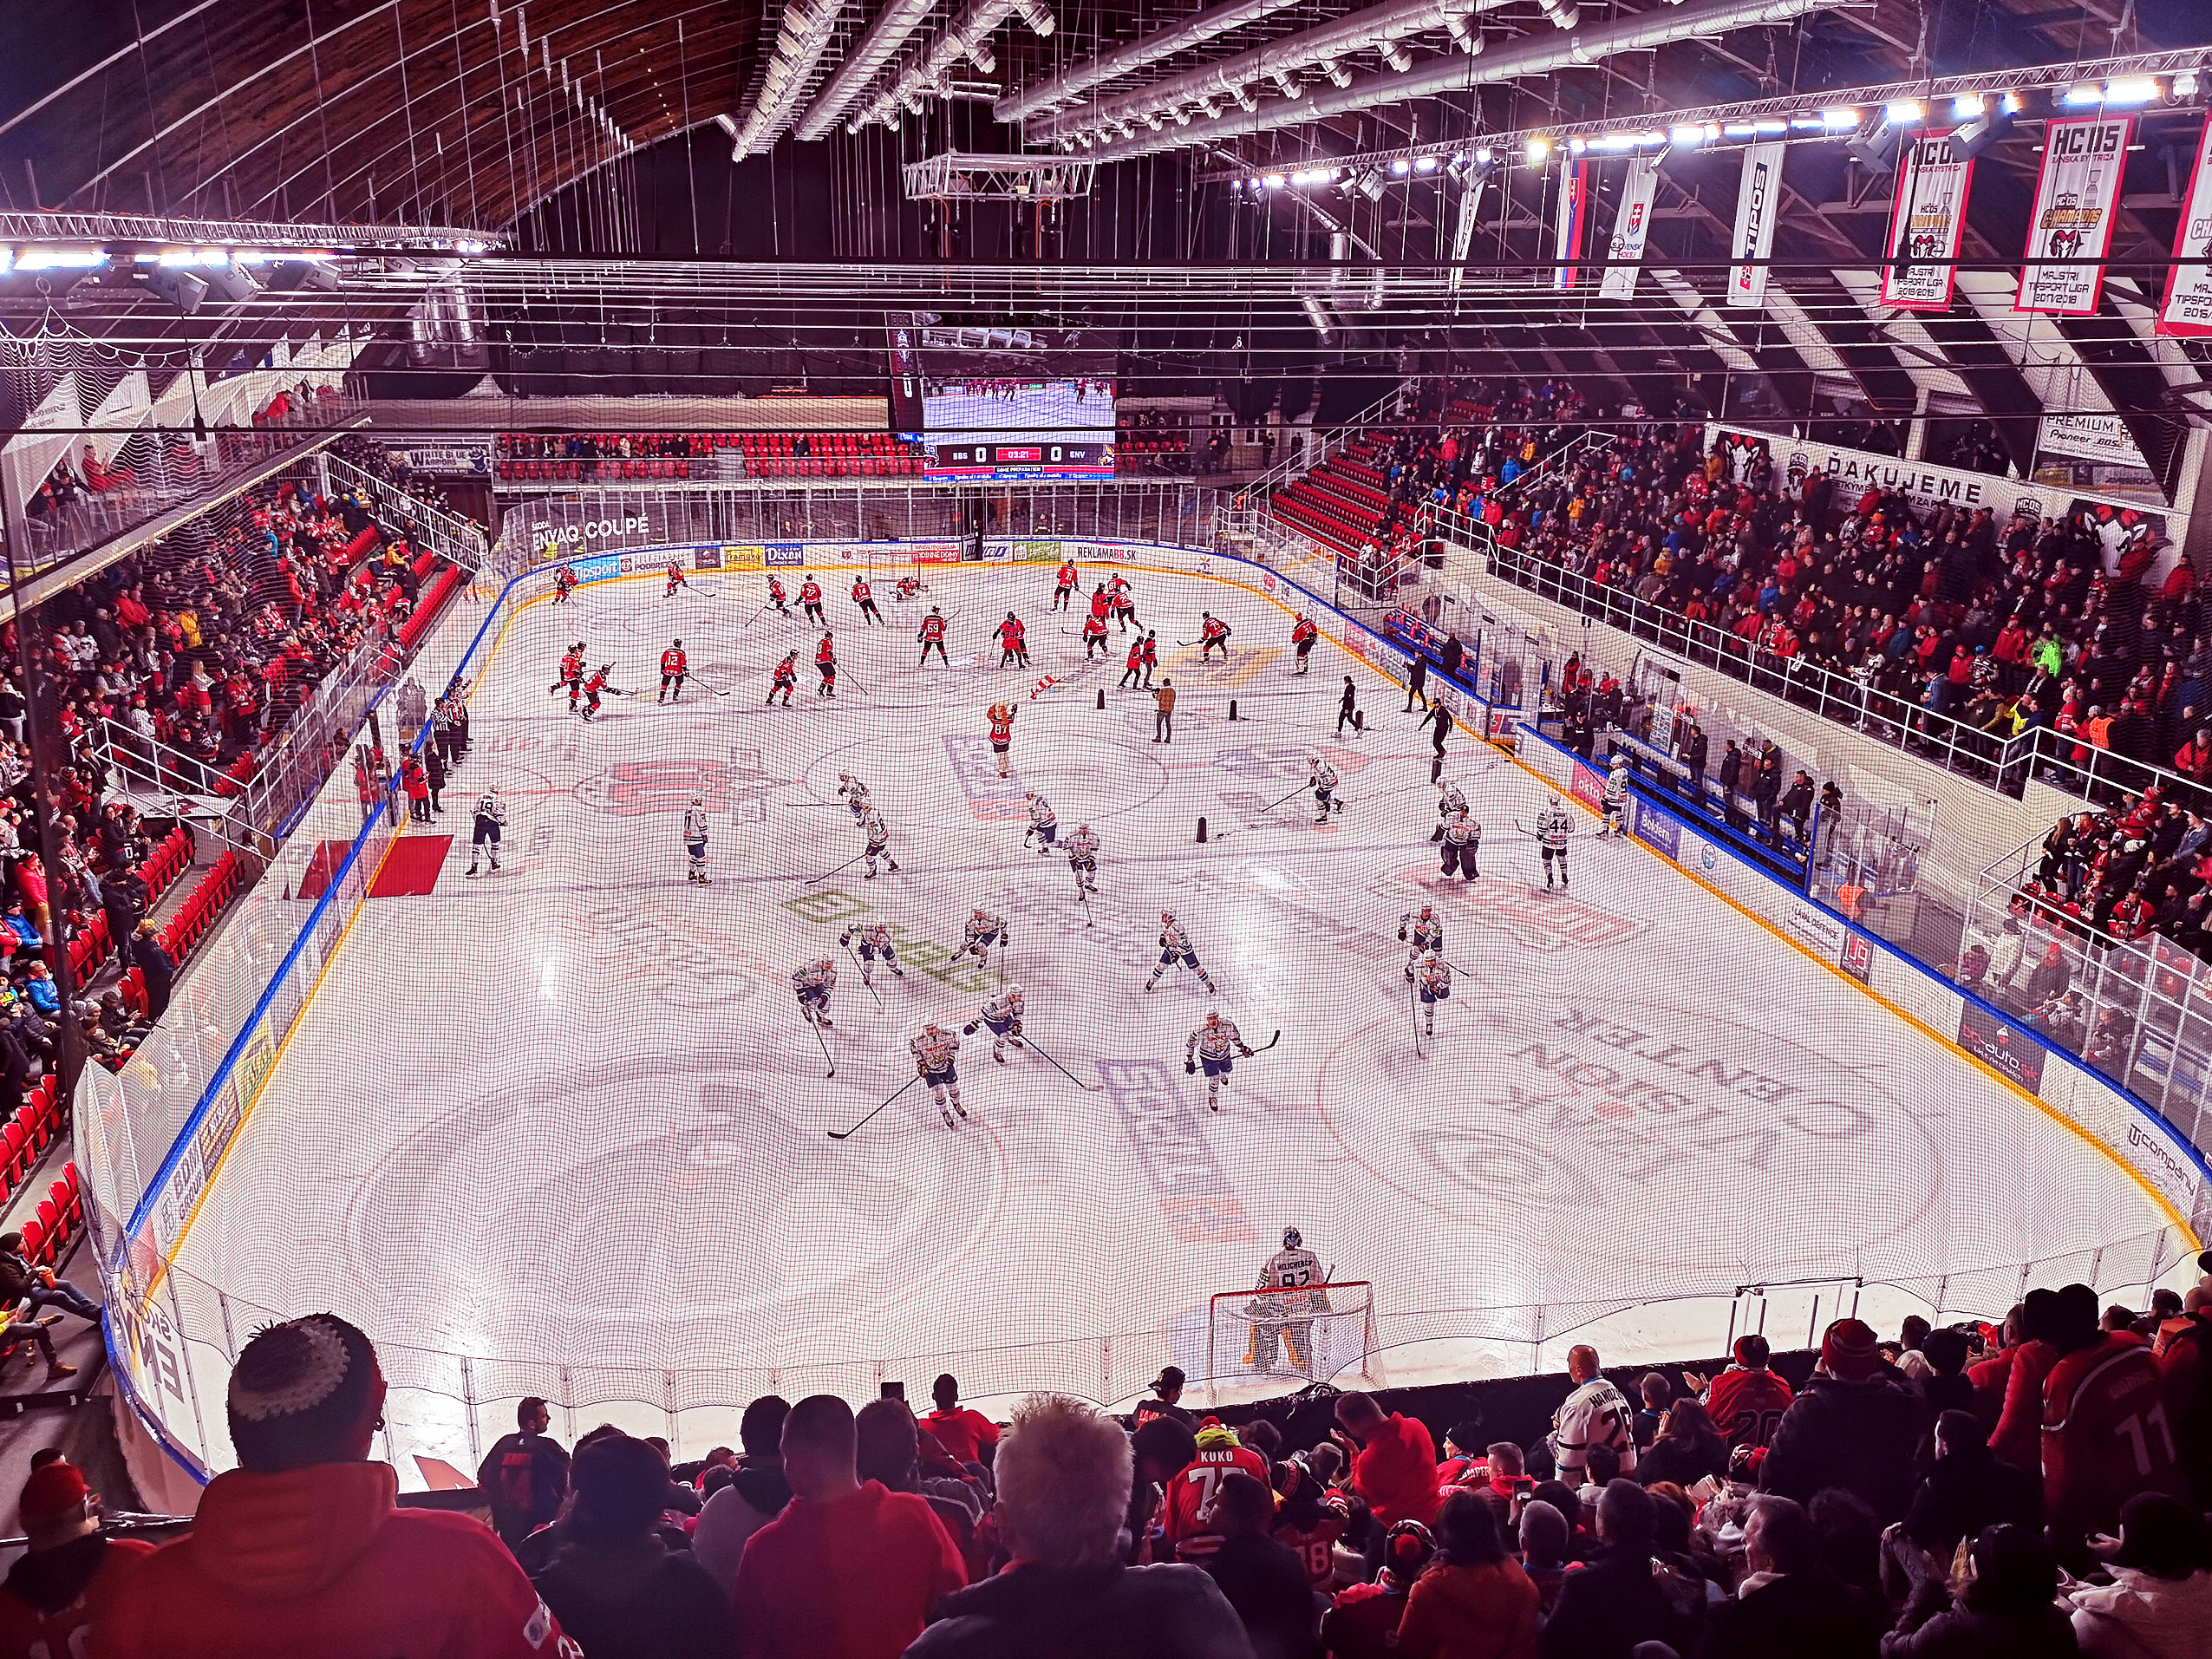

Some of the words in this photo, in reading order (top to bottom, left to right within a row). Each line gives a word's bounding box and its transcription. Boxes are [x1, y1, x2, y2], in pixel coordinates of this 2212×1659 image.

[1745, 165, 1766, 256] TIPOS
[2069, 283, 2089, 293] LIGA
[2046, 415, 2114, 433] PREMIUM
[2050, 429, 2091, 443] Pioneer
[975, 447, 987, 462] 0
[1050, 446, 1062, 462] 0
[1827, 451, 1983, 505] ĎAKUJEME
[532, 525, 580, 552] ENYAQ
[584, 513, 649, 539] COUPÉ
[1078, 546, 1137, 561] REKLAMABB.SK
[573, 562, 618, 580] Tipsport
[927, 623, 939, 633] 69
[1549, 820, 1569, 832] 44
[1727, 1410, 1784, 1447] 20
[2114, 1401, 2177, 1477] 11
[1200, 1450, 1234, 1463] KUKO
